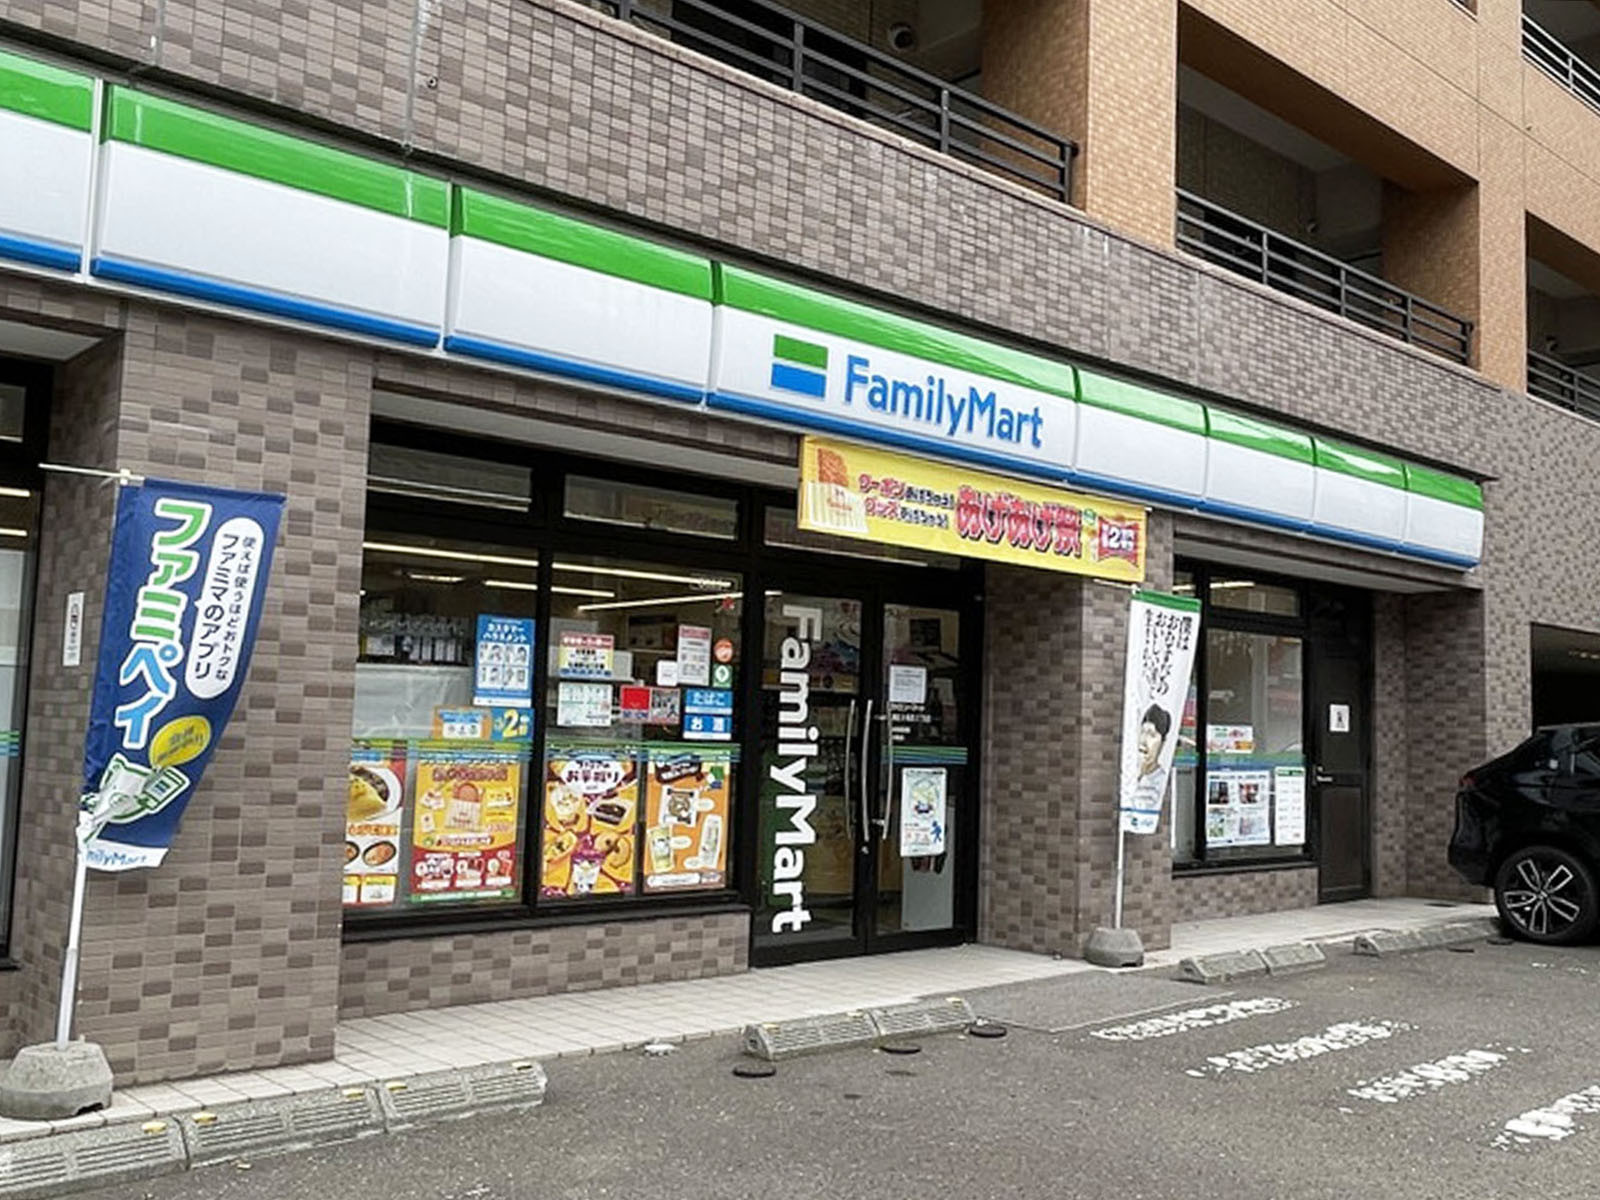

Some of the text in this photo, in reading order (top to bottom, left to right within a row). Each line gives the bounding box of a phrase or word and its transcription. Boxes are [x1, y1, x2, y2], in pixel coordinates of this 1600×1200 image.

[844, 354, 1044, 448] FamilyMart
[115, 499, 211, 748] ファミペイ
[195, 533, 239, 679] ファミマのアプリ
[216, 536, 256, 680] 使えば使うほどおトクな
[771, 603, 824, 934] FamilyMart
